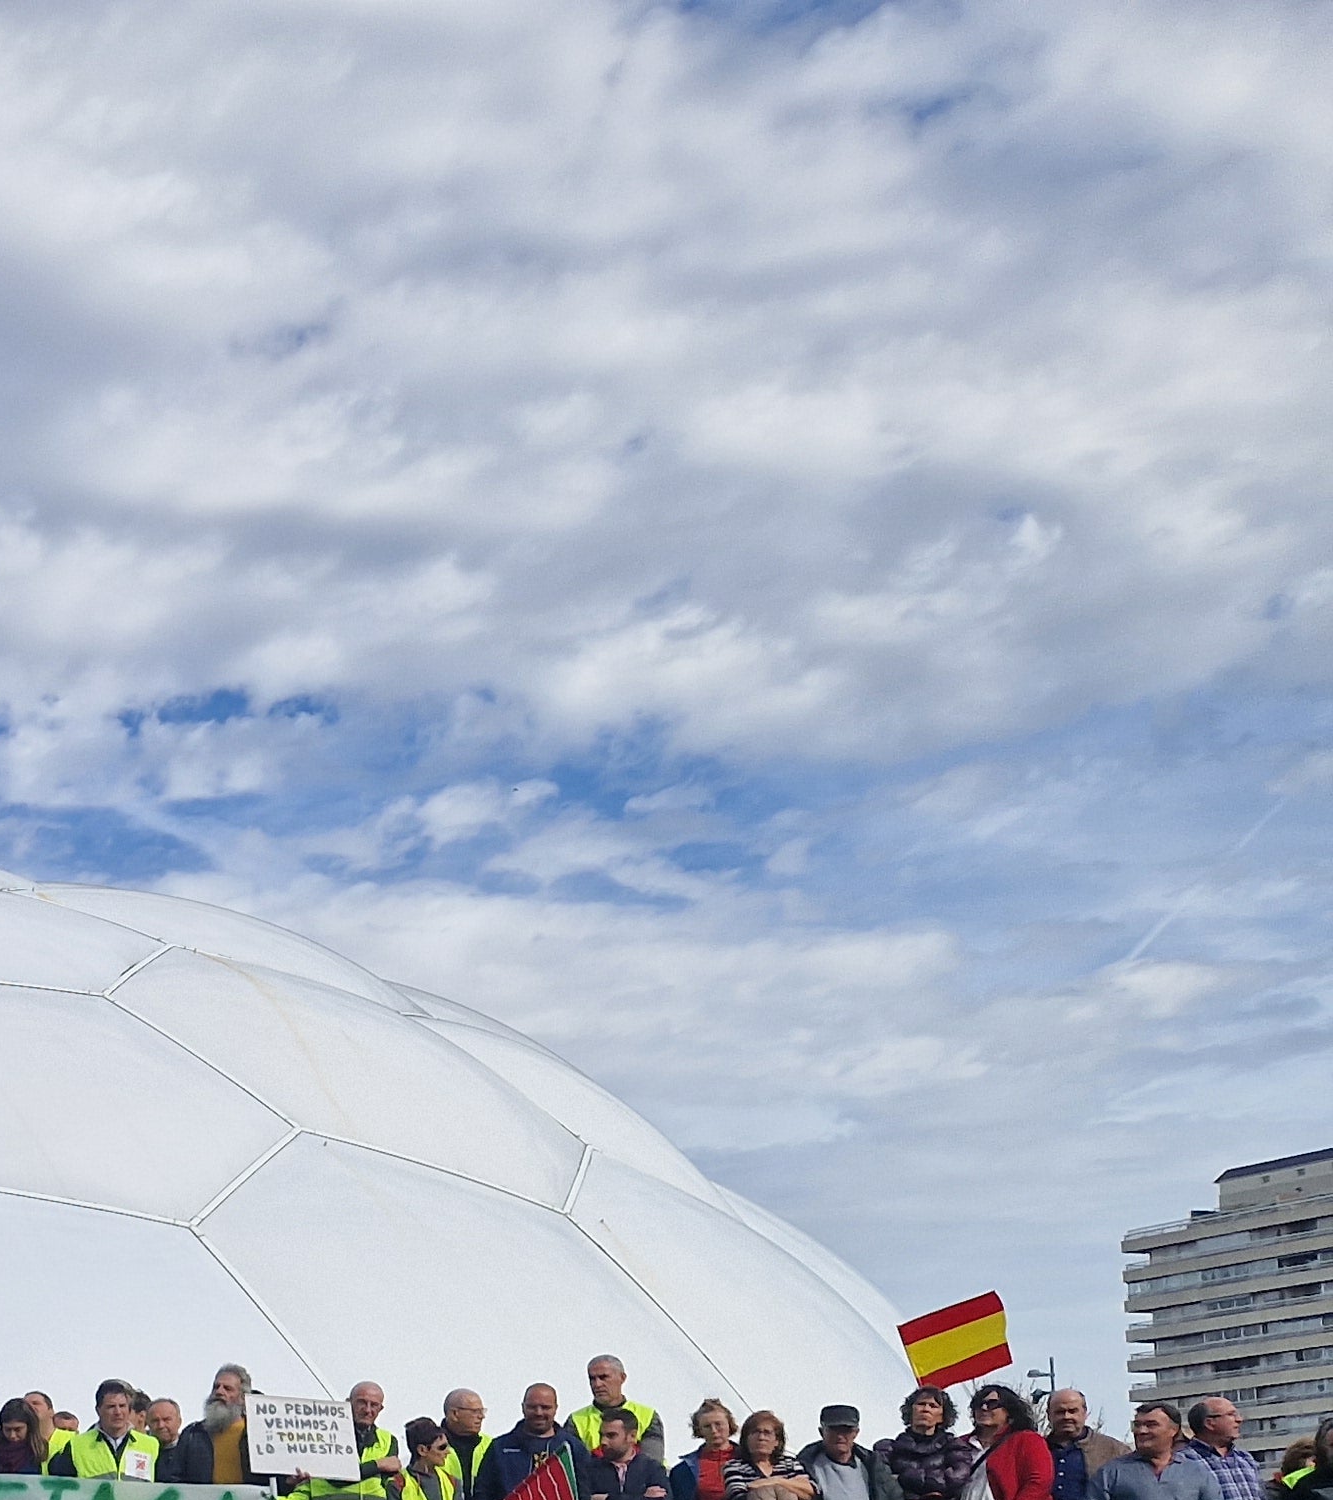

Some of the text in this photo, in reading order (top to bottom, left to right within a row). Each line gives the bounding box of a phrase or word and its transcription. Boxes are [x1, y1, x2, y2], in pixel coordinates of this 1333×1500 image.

[255, 1403, 277, 1415] NO
[330, 1420, 339, 1431] A
[256, 1443, 354, 1456] LO NUESTRO
